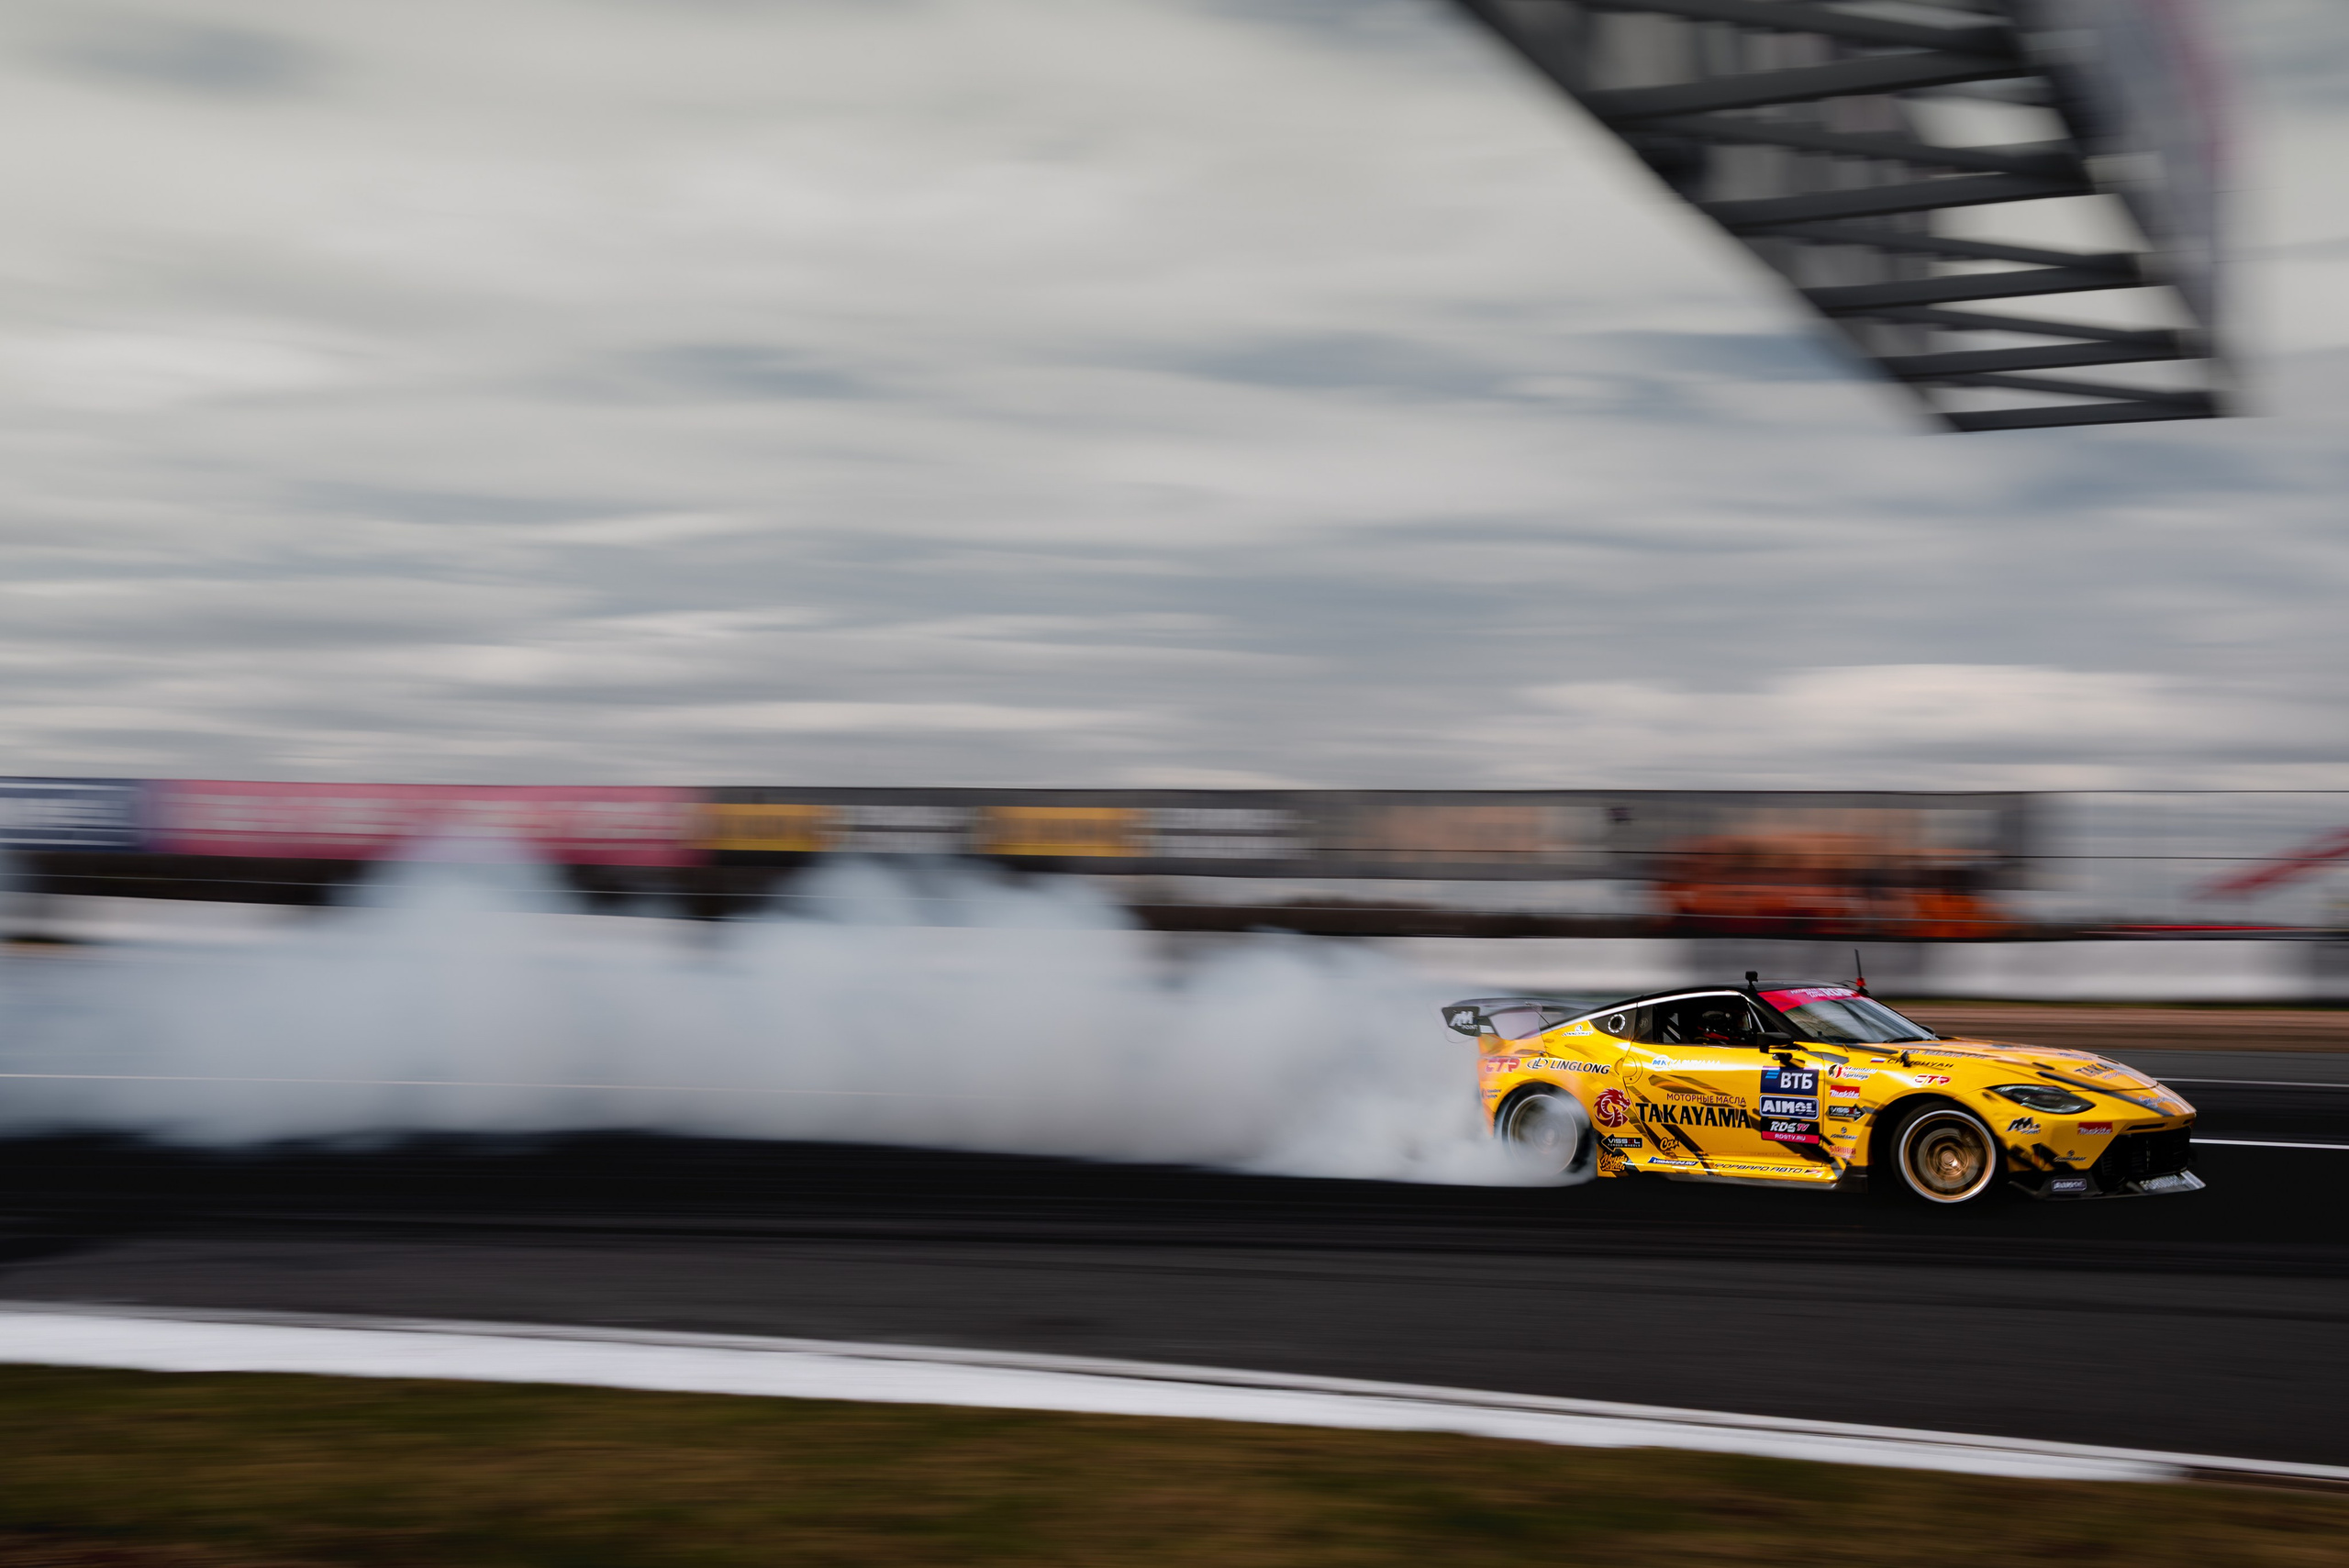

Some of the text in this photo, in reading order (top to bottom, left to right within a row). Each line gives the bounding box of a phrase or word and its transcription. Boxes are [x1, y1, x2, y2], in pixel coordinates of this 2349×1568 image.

[1550, 1060, 1610, 1074] LINGLONG
[1780, 1072, 1813, 1090] ВТБ
[1666, 1093, 1747, 1105] МОТОРНЫЕ МАСЛА
[1762, 1099, 1816, 1116] AIMOL
[1635, 1102, 1753, 1129] TAKAYAMA
[1775, 1133, 1806, 1141] RDSTV.RU
[1769, 1166, 1802, 1174] АВТО
